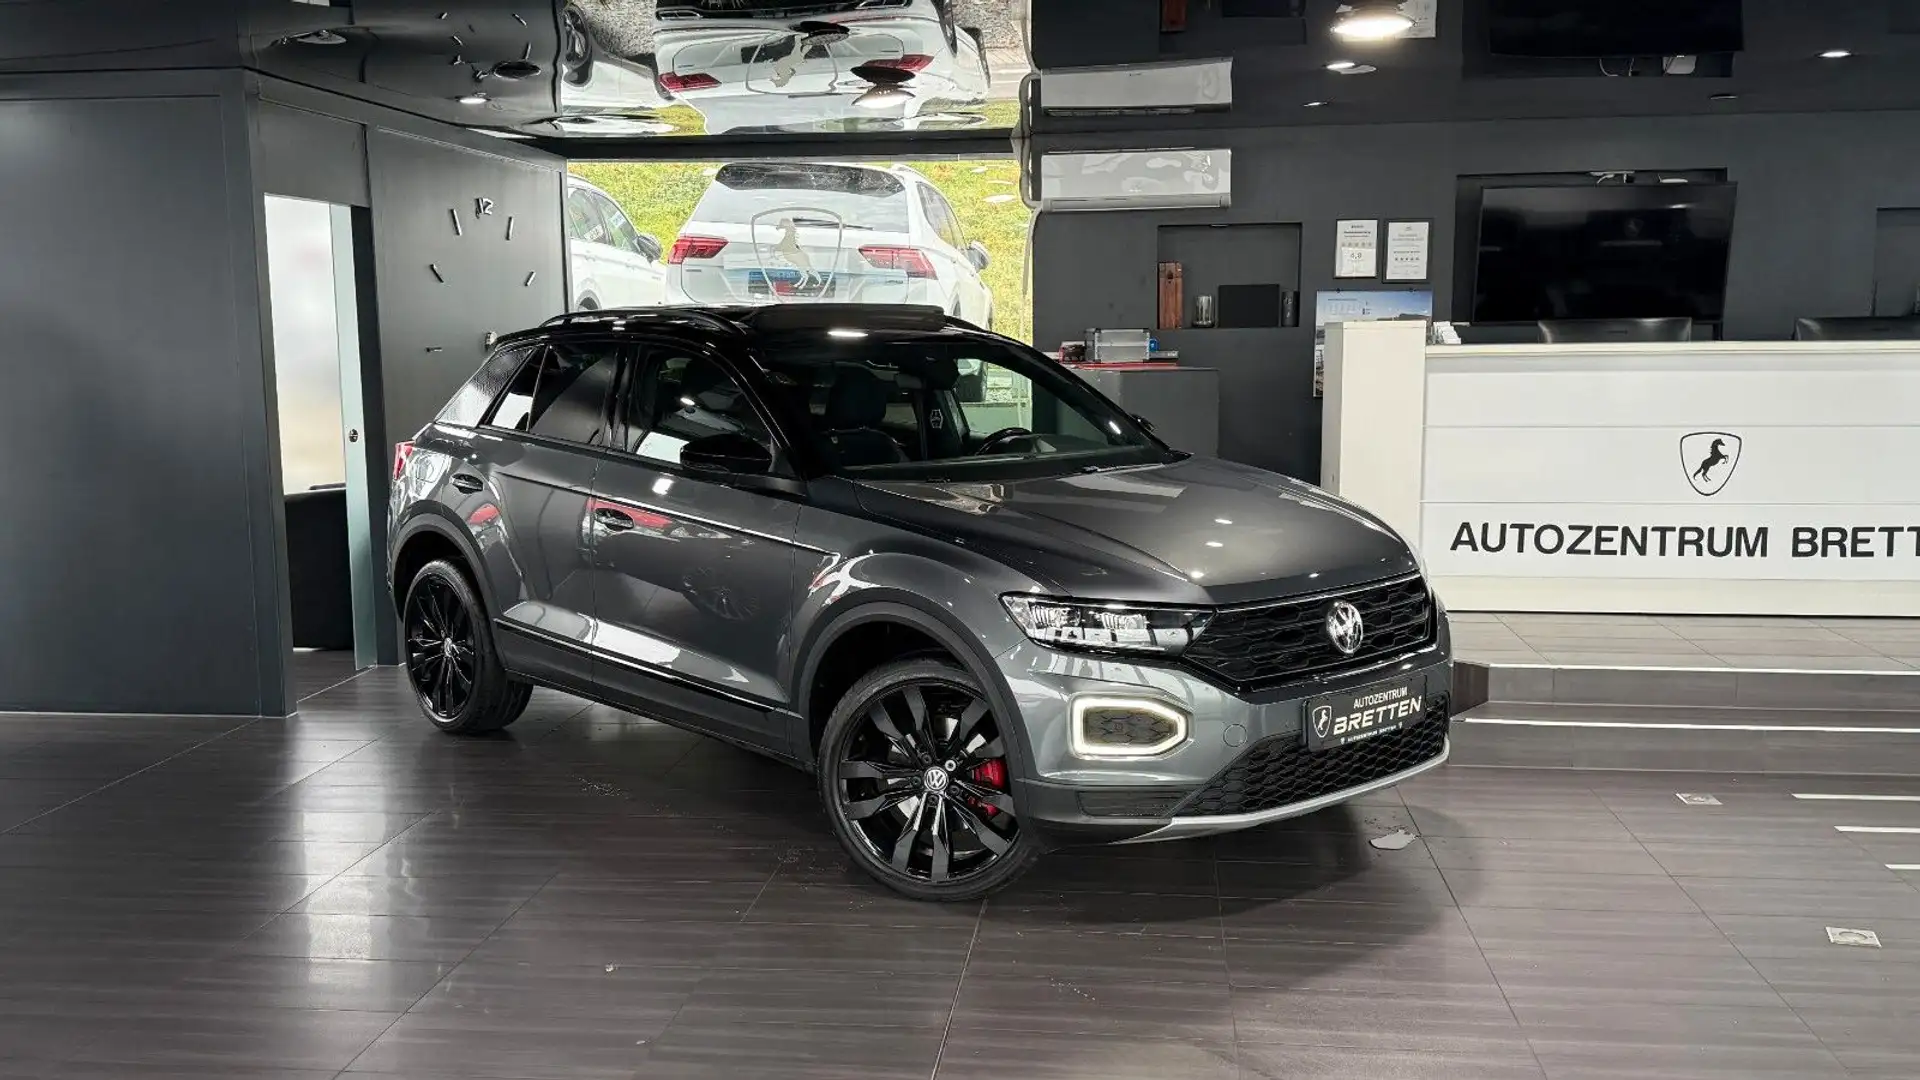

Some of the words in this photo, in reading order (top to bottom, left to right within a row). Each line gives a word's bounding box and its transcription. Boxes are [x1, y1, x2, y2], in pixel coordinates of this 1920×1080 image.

[1450, 522, 1768, 557] AUTOZENTRUM
[1333, 695, 1422, 735] BRETTEN
[1353, 686, 1408, 709] AUTOZENTRUM
